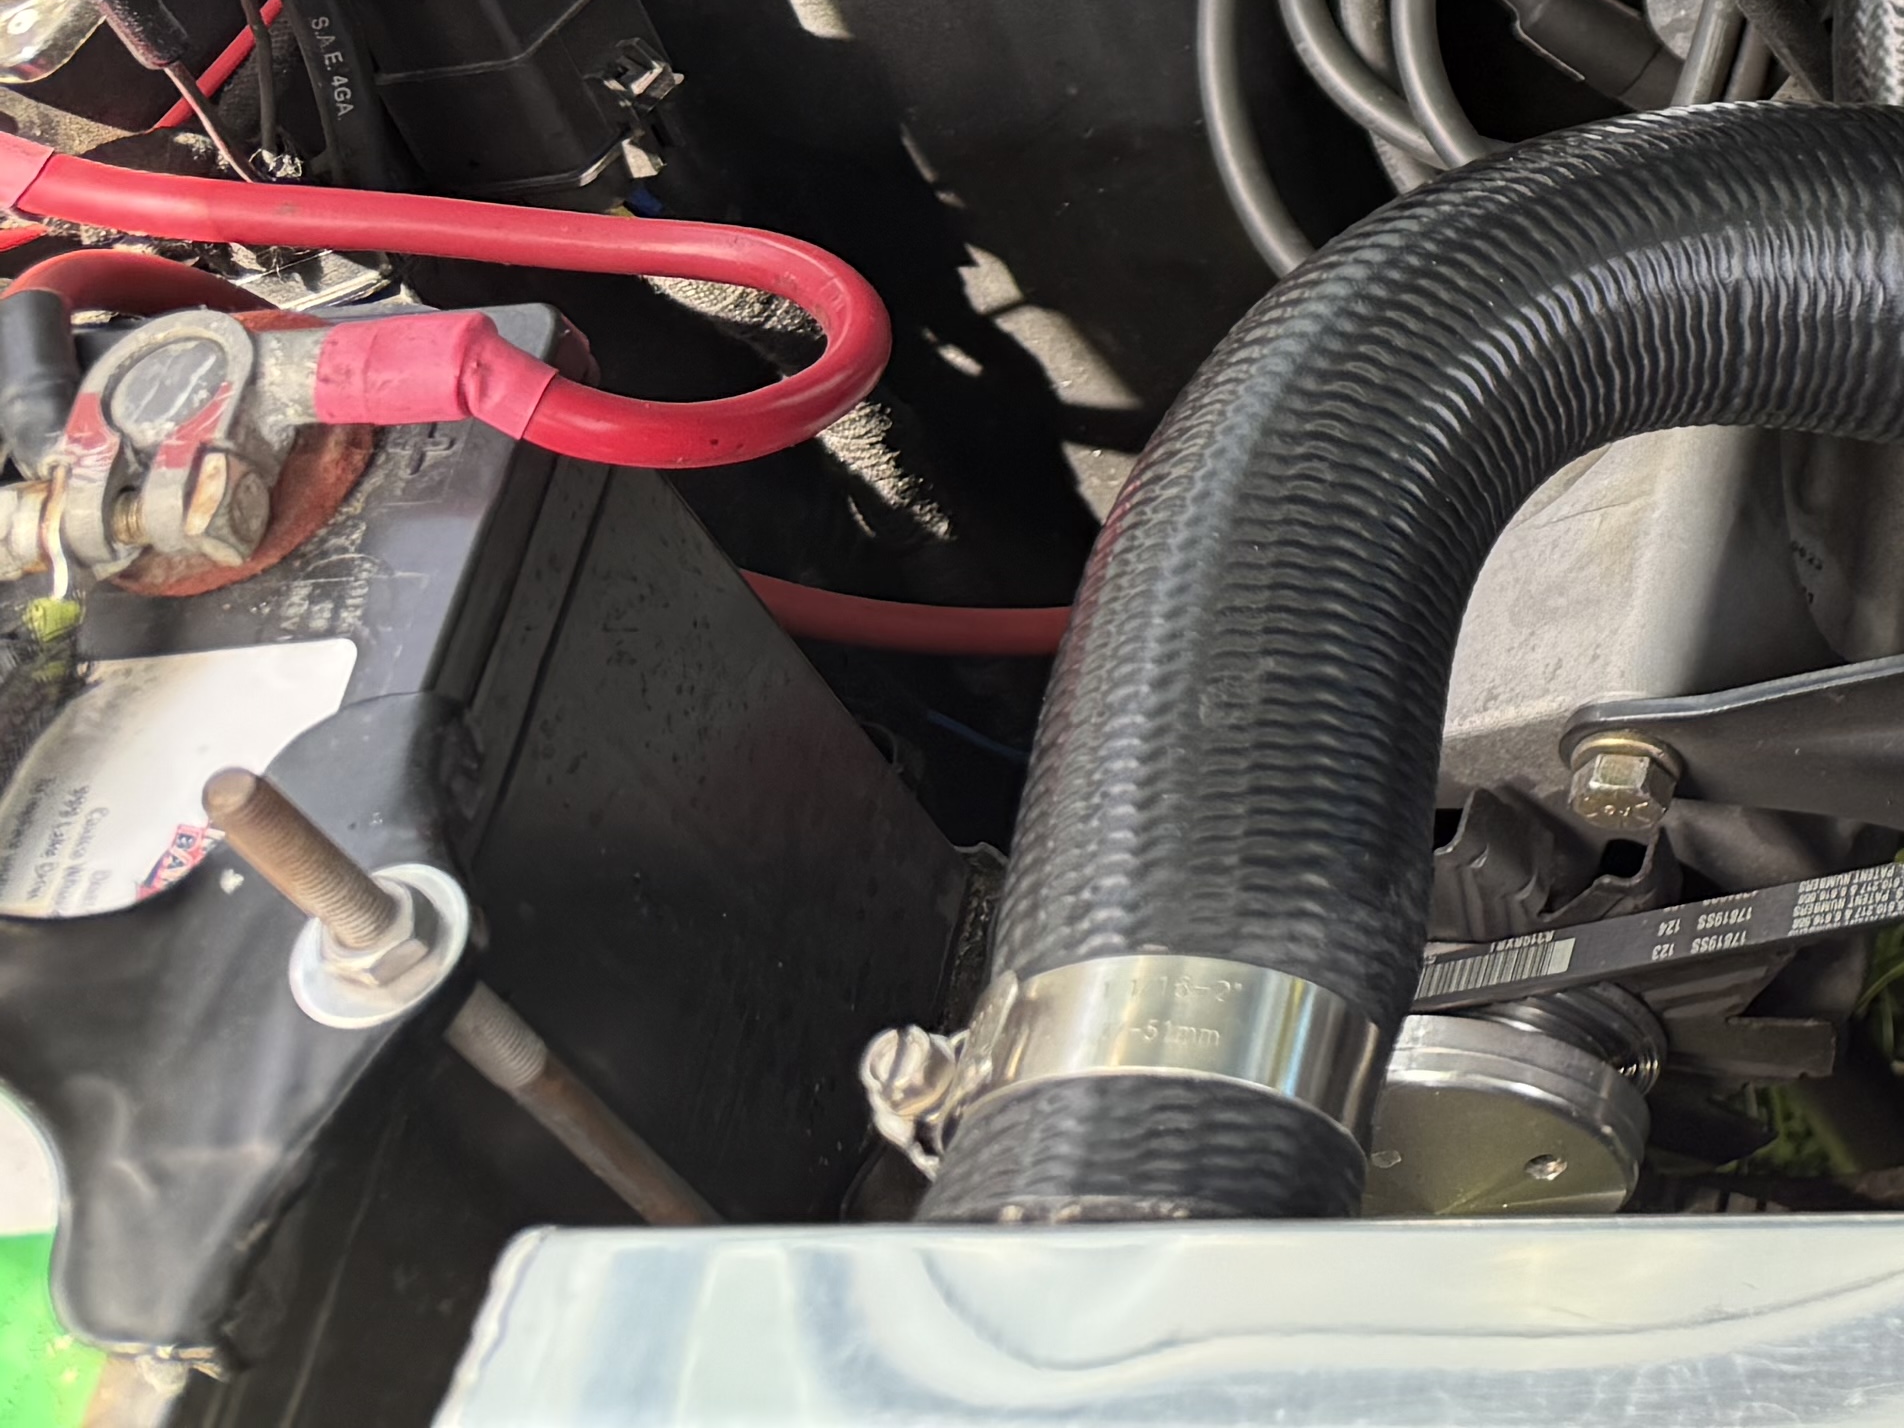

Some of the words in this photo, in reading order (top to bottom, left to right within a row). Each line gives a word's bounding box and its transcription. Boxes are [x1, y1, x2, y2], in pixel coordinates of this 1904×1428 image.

[311, 15, 344, 72] S.A.E.
[1798, 869, 1852, 894] NUMBERS
[1852, 863, 1896, 885] PATENT
[1792, 894, 1847, 919] NUMBERS
[1847, 887, 1889, 908] PATENT
[1656, 917, 1681, 937] 124
[1651, 942, 1677, 962] 123
